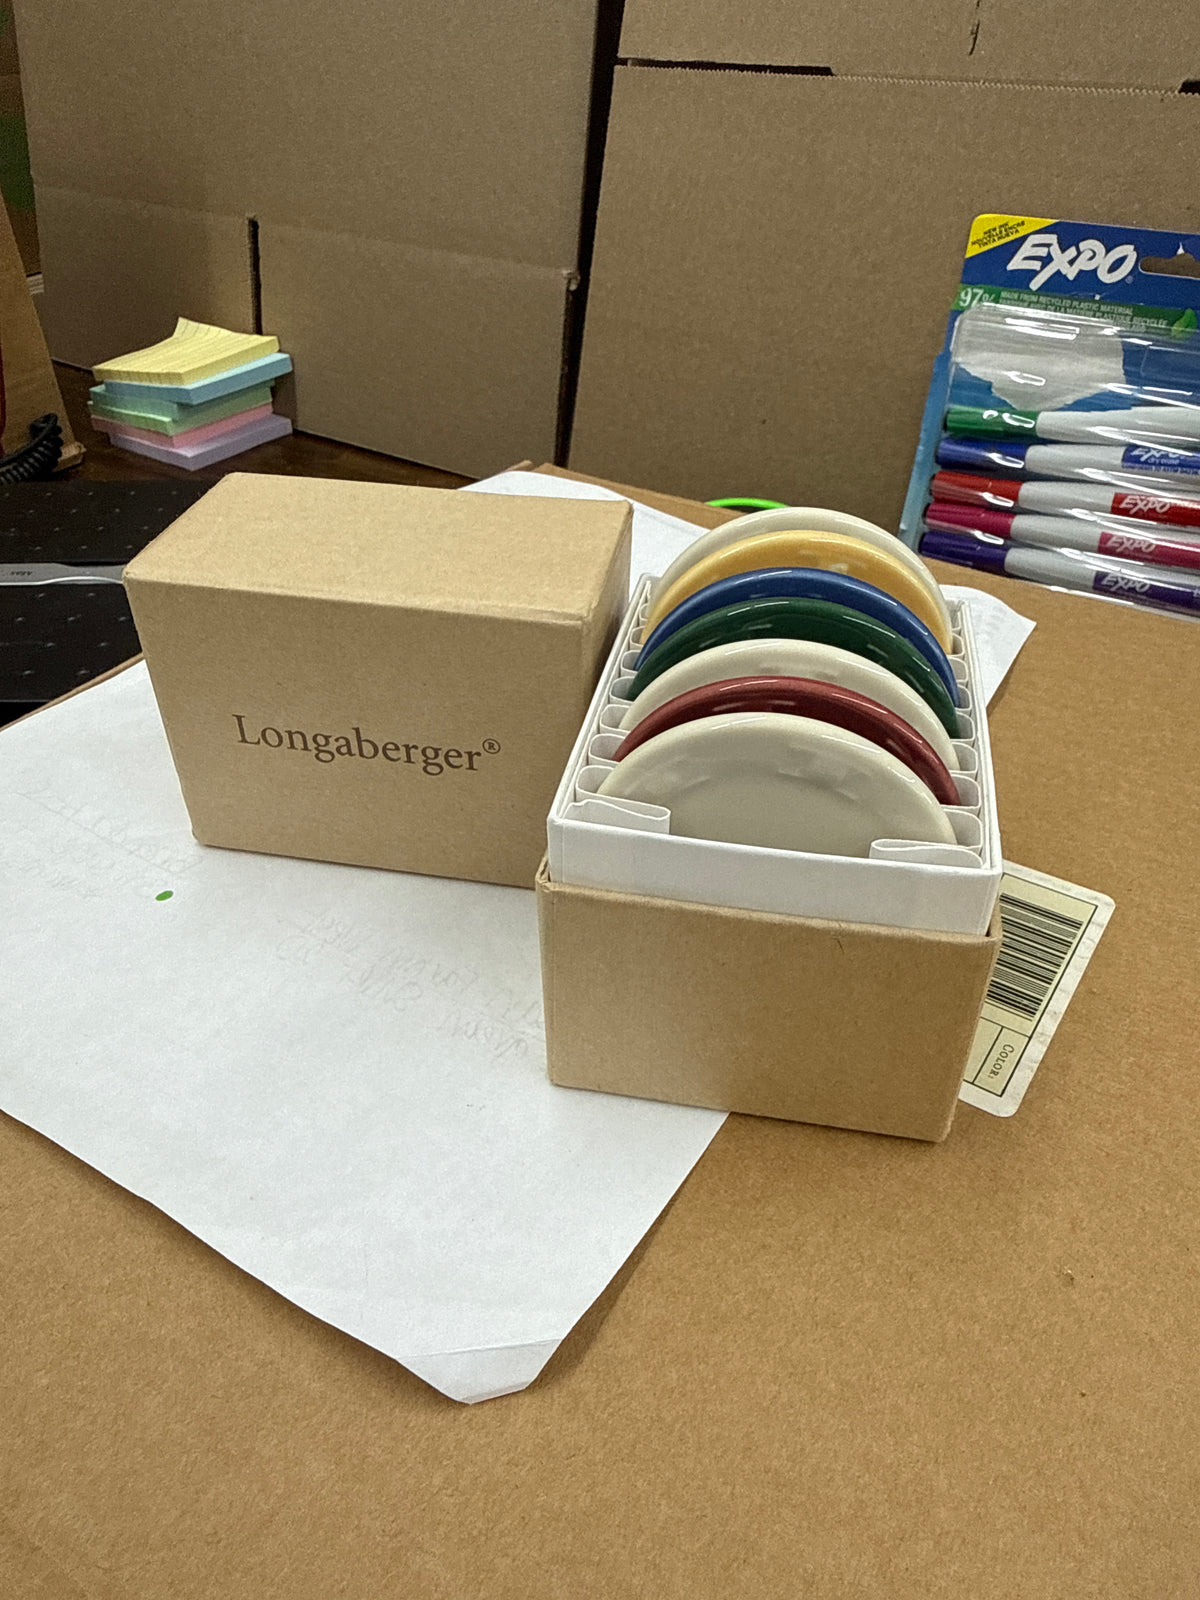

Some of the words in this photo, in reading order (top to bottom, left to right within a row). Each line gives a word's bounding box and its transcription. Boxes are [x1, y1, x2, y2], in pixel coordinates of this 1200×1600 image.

[1006, 233, 1137, 291] EXPO
[1019, 292, 1039, 303] FROM
[1039, 294, 1071, 307] RECYCLED
[1072, 299, 1099, 311] PLASTIC
[1119, 495, 1171, 515] EXPO
[1106, 535, 1157, 553] EXPO
[1101, 573, 1151, 593] EXPO
